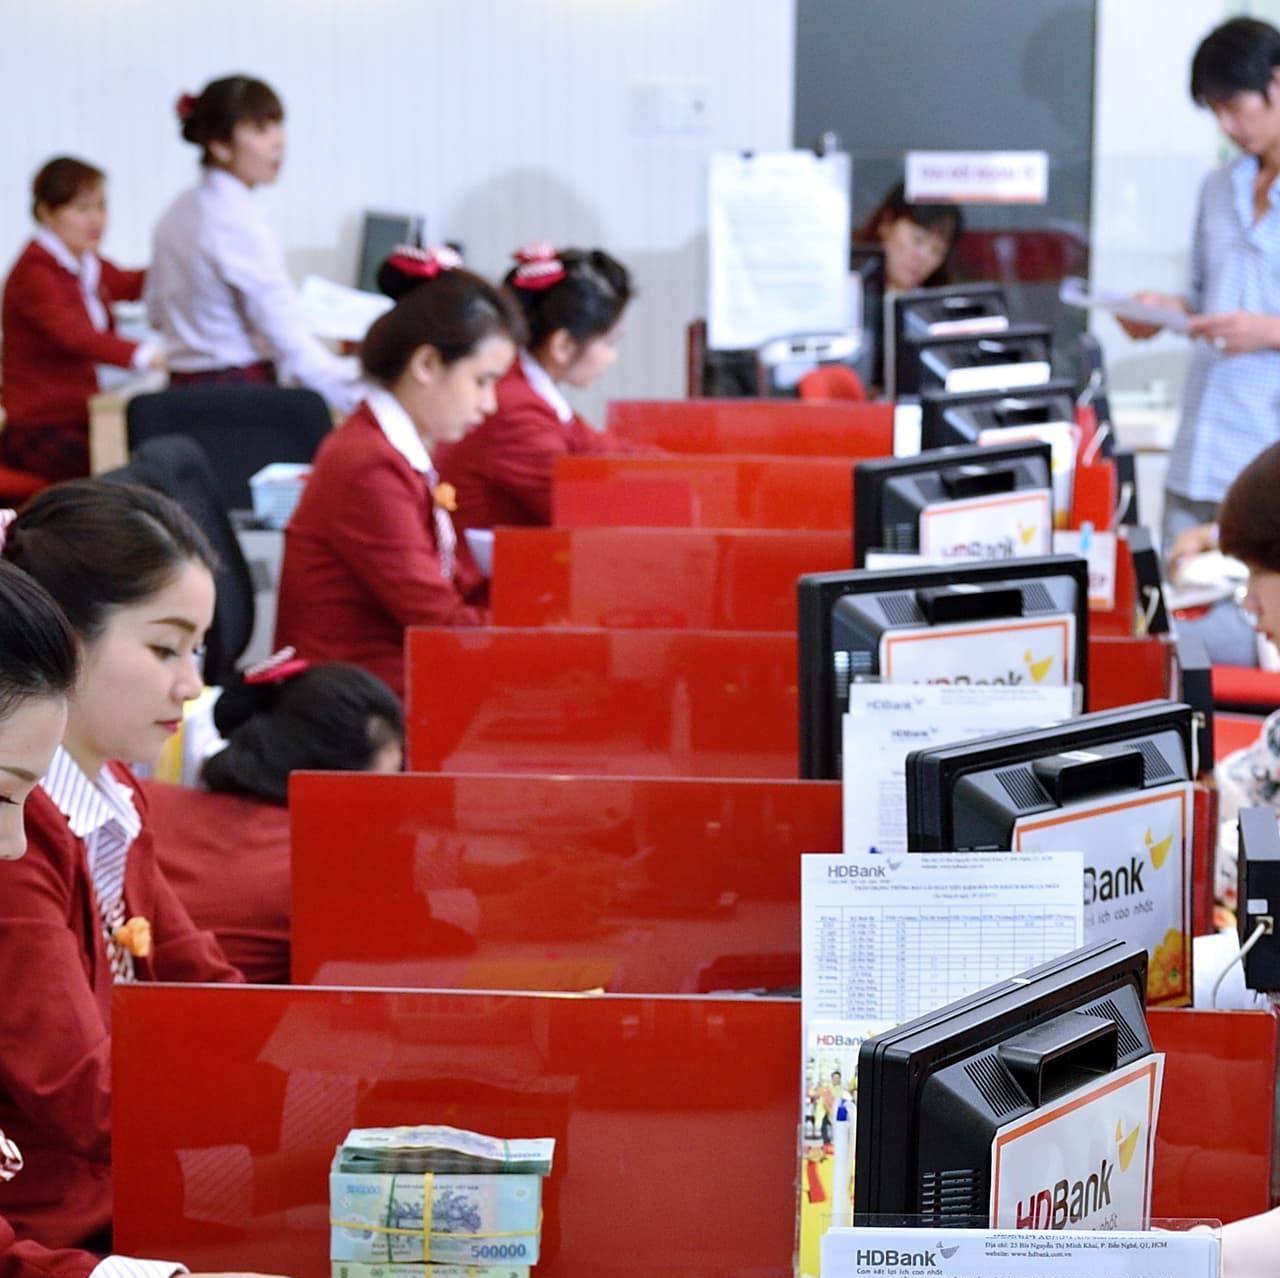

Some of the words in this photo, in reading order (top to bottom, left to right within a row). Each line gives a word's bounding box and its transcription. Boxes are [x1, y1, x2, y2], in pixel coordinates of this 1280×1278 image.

[827, 864, 886, 878] HDBank
[1016, 1159, 1114, 1230] HDBank
[471, 1244, 526, 1258] 500000
[856, 1249, 936, 1266] HDBank
